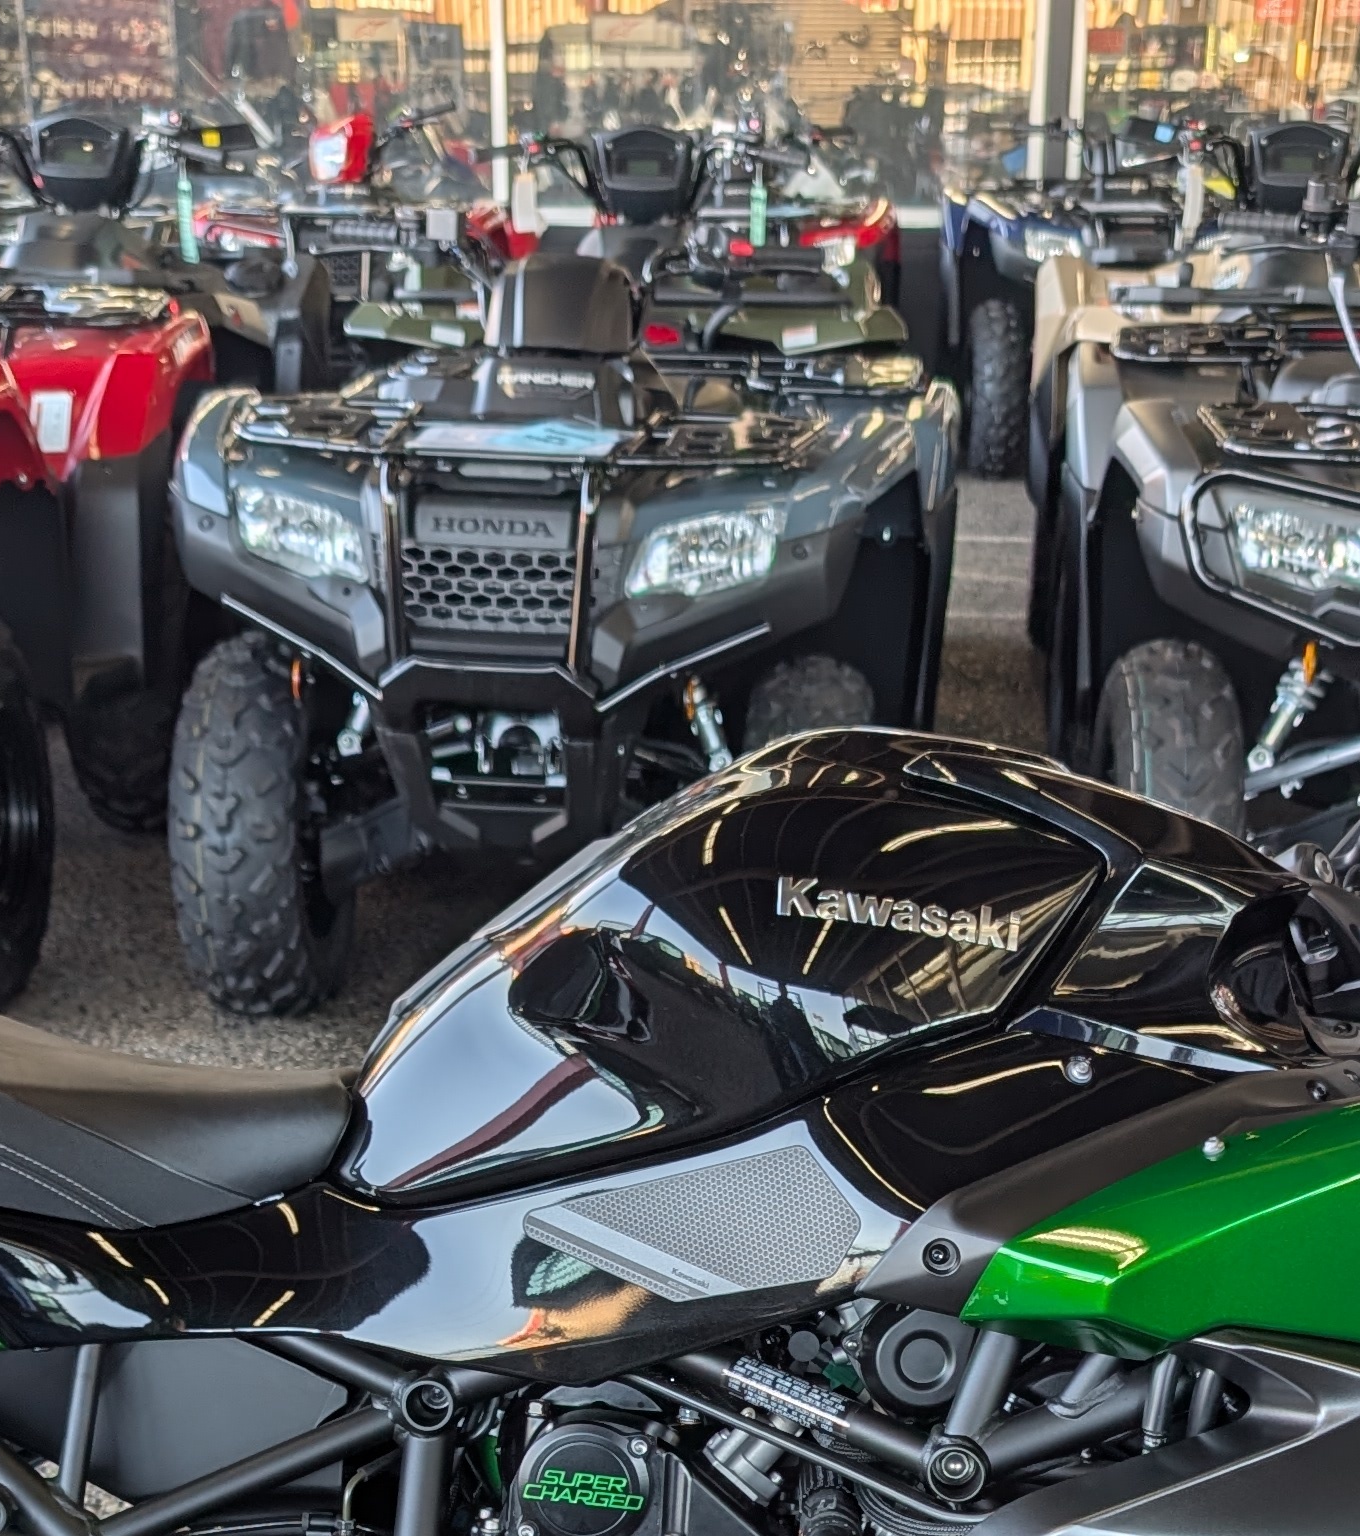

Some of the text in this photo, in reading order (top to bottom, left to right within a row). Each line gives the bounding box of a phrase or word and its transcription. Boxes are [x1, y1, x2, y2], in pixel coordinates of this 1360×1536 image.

[432, 514, 554, 540] HONDA
[776, 876, 1021, 952] Kawasaki
[671, 1267, 710, 1290] Kawasaki
[540, 1469, 629, 1493] SUPER
[522, 1483, 645, 1511] CHARGED
